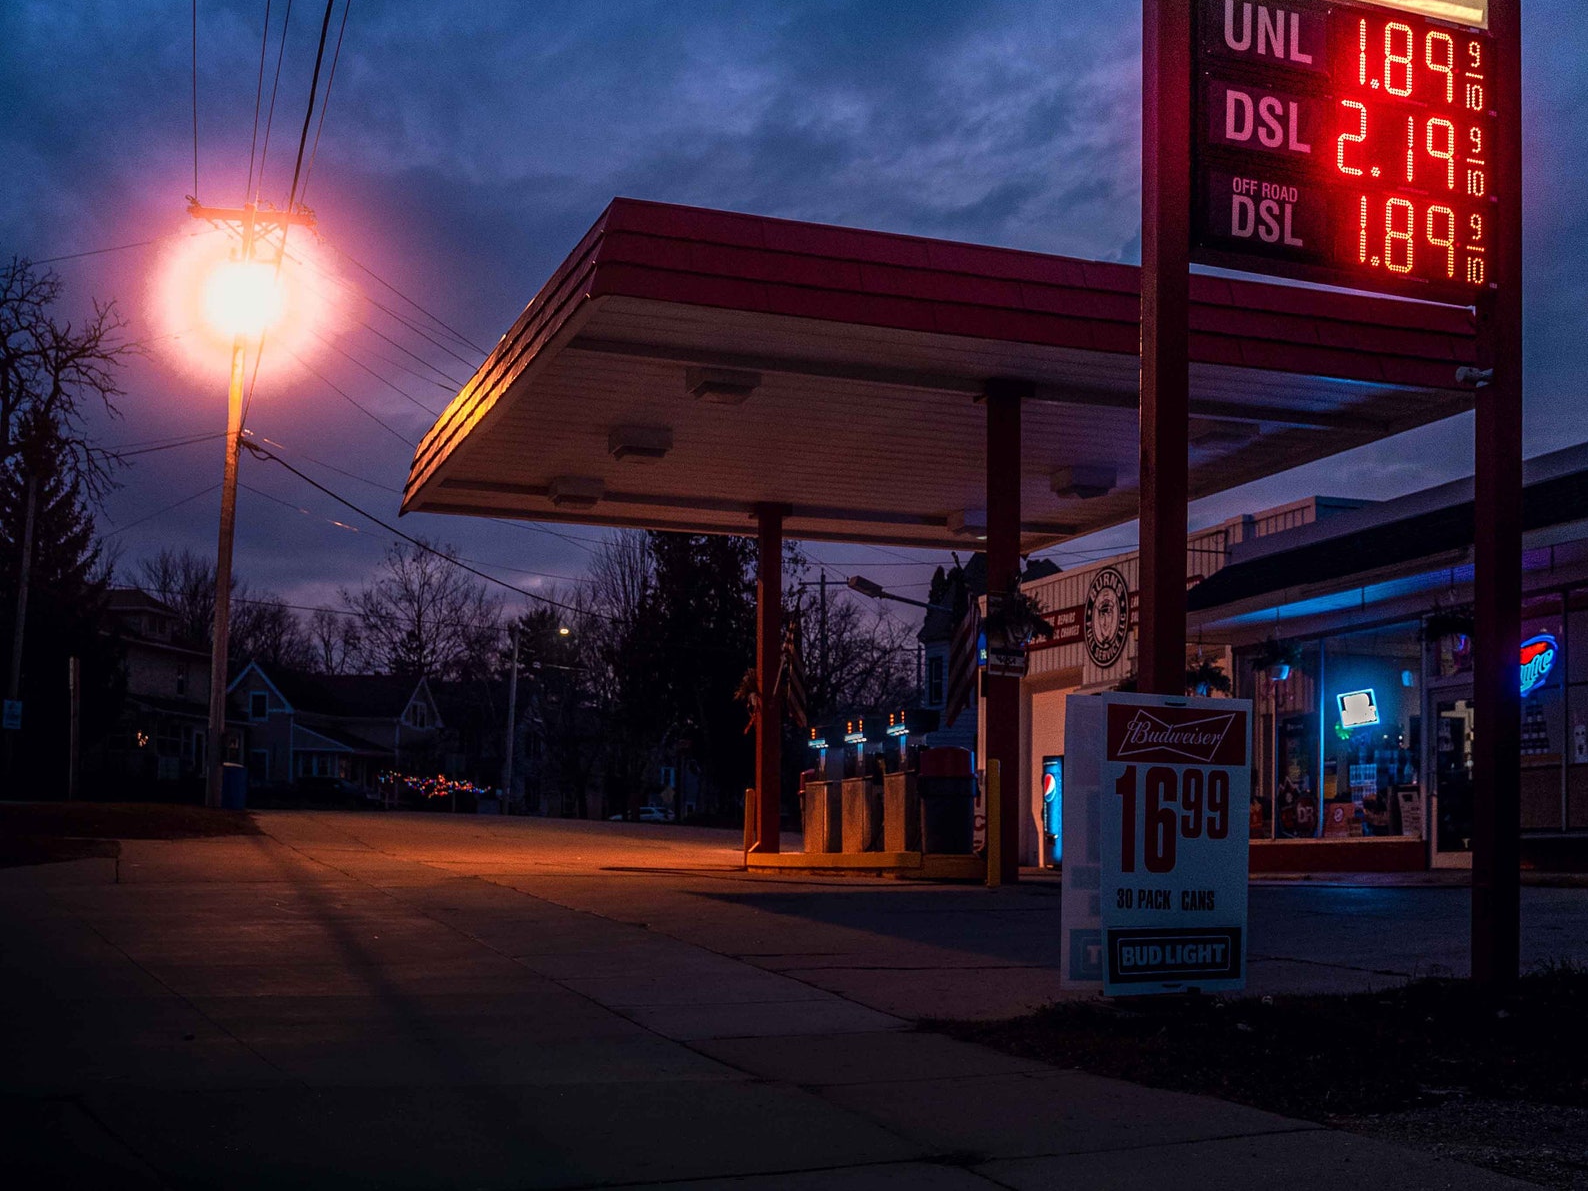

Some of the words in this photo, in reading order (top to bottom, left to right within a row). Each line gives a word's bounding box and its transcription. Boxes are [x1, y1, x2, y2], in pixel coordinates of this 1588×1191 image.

[1224, 0, 1312, 64] UNL
[1359, 18, 1453, 103] 1.89
[1225, 89, 1311, 153] DSL
[1337, 99, 1454, 189] 2.19
[1232, 177, 1258, 196] OFF
[1261, 179, 1298, 203] ROAD
[1231, 194, 1303, 246] DSL
[1359, 196, 1454, 278] 1.89
[1089, 573, 1123, 602] BURNS
[1127, 719, 1223, 745] Budweiser
[1116, 888, 1133, 909] 30
[1138, 890, 1172, 910] PACK
[1181, 890, 1215, 911] CANS
[1122, 946, 1162, 966] BUD
[1165, 944, 1226, 965] LIGHT
